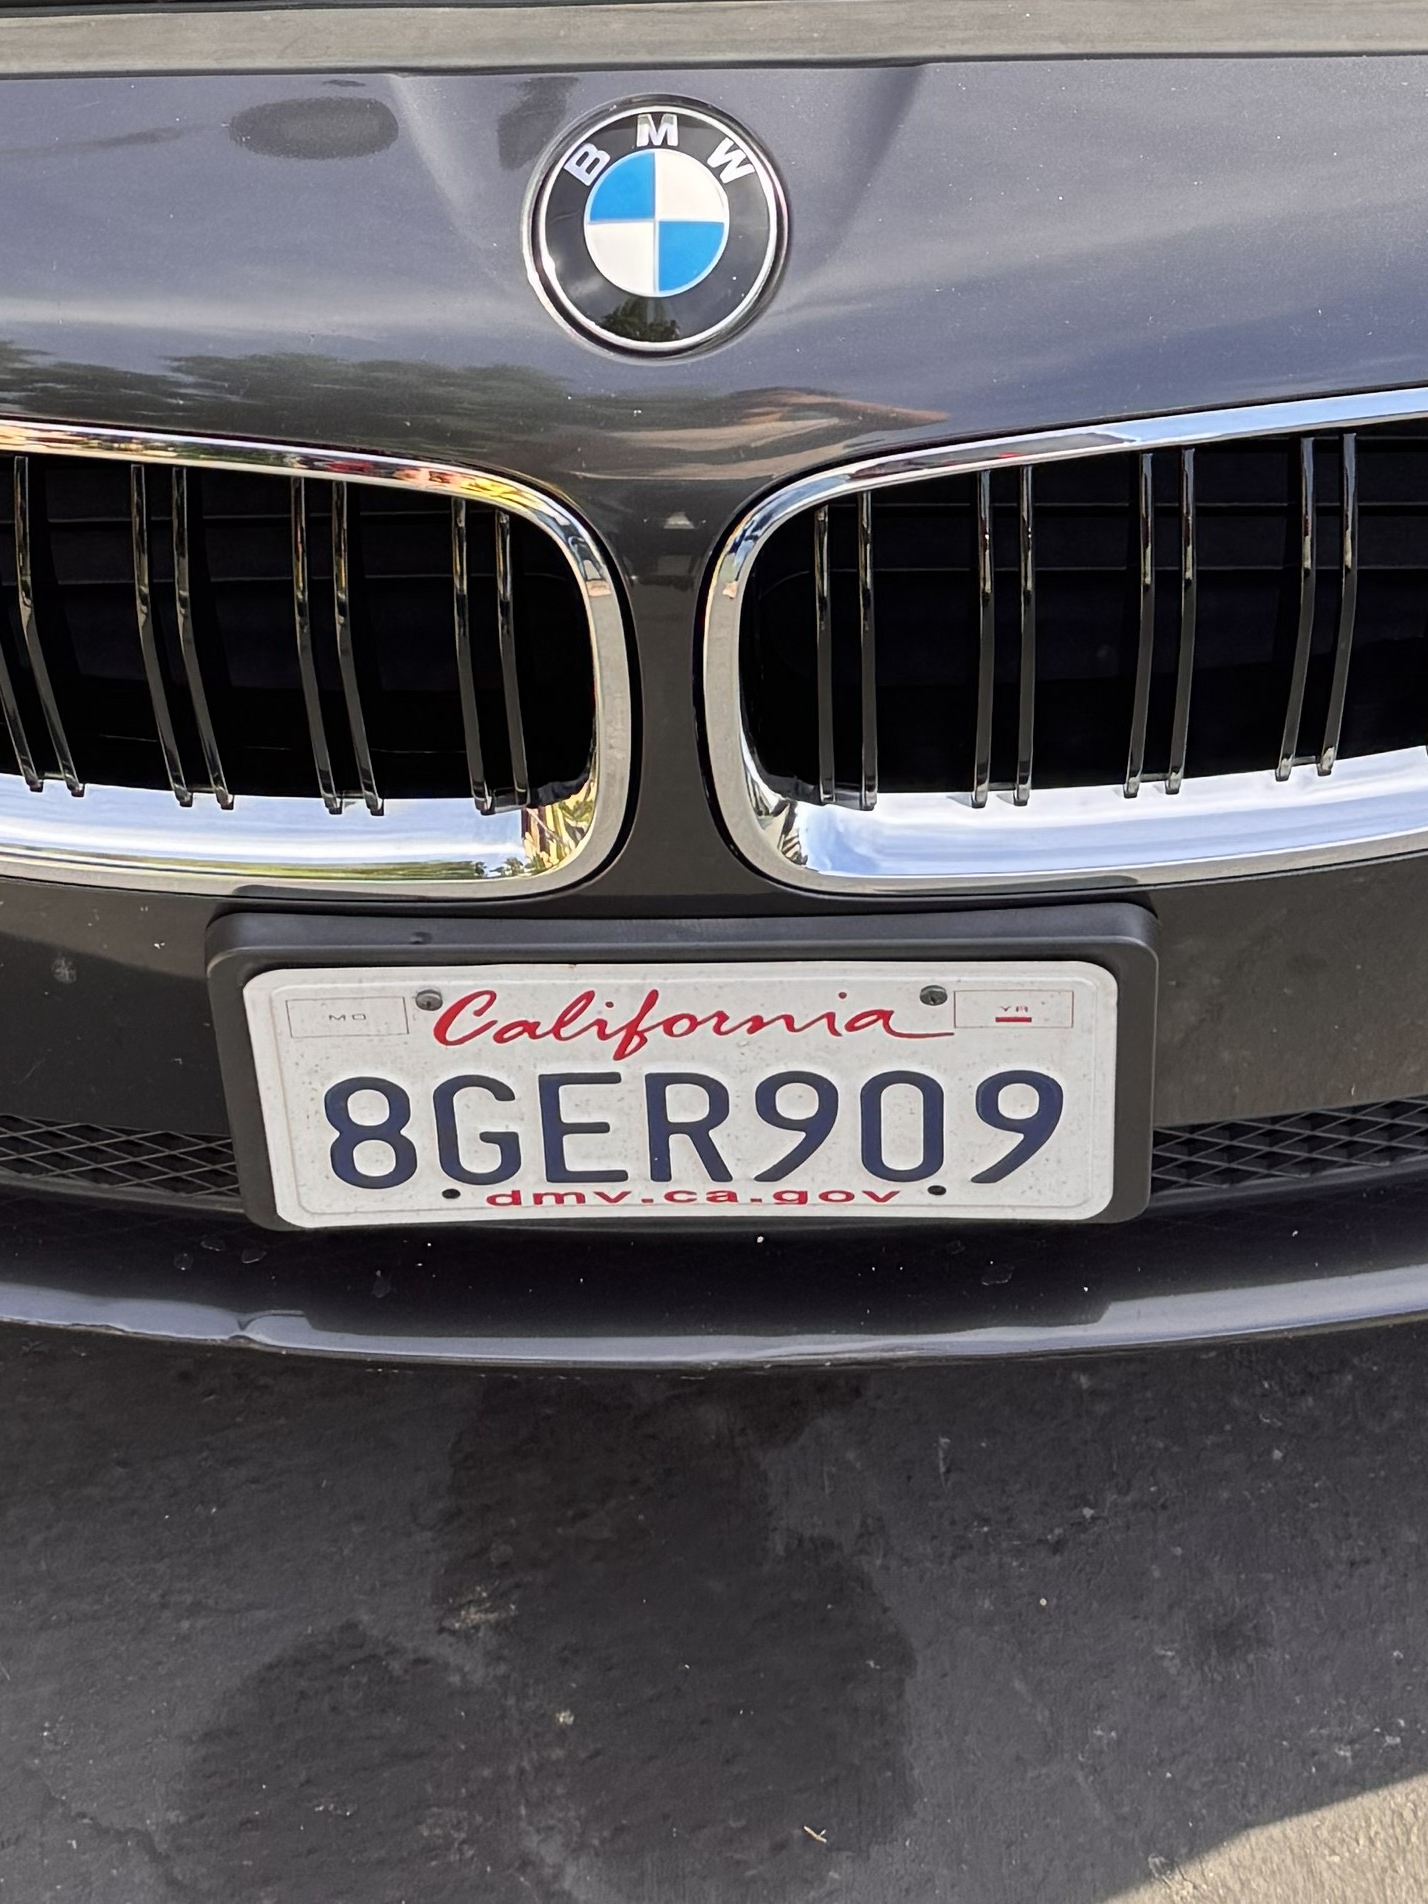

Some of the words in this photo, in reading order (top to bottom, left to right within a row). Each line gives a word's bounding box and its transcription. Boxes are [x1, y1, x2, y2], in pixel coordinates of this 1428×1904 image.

[563, 112, 756, 187] BMW
[433, 988, 955, 1062] California
[323, 1069, 1066, 1191] 8GER909
[485, 1186, 903, 1208] dmv.ca.gov
